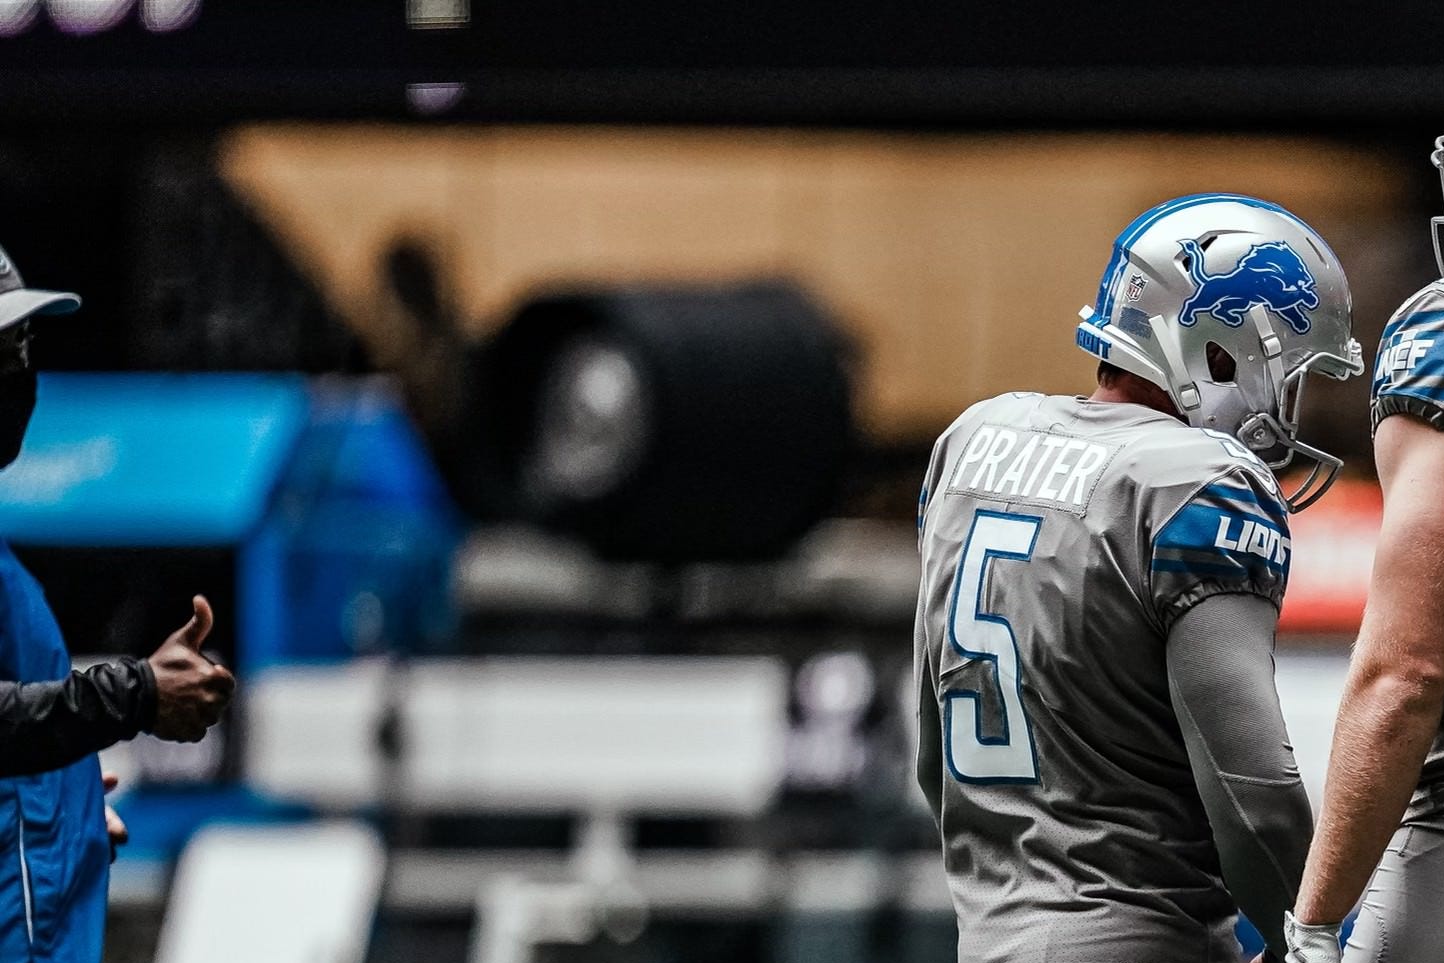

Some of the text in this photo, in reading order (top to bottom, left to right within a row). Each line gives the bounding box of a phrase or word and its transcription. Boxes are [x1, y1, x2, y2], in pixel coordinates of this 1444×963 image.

[953, 427, 1107, 506] PRATER
[1214, 515, 1291, 566] LIONS
[942, 508, 1044, 786] 5
